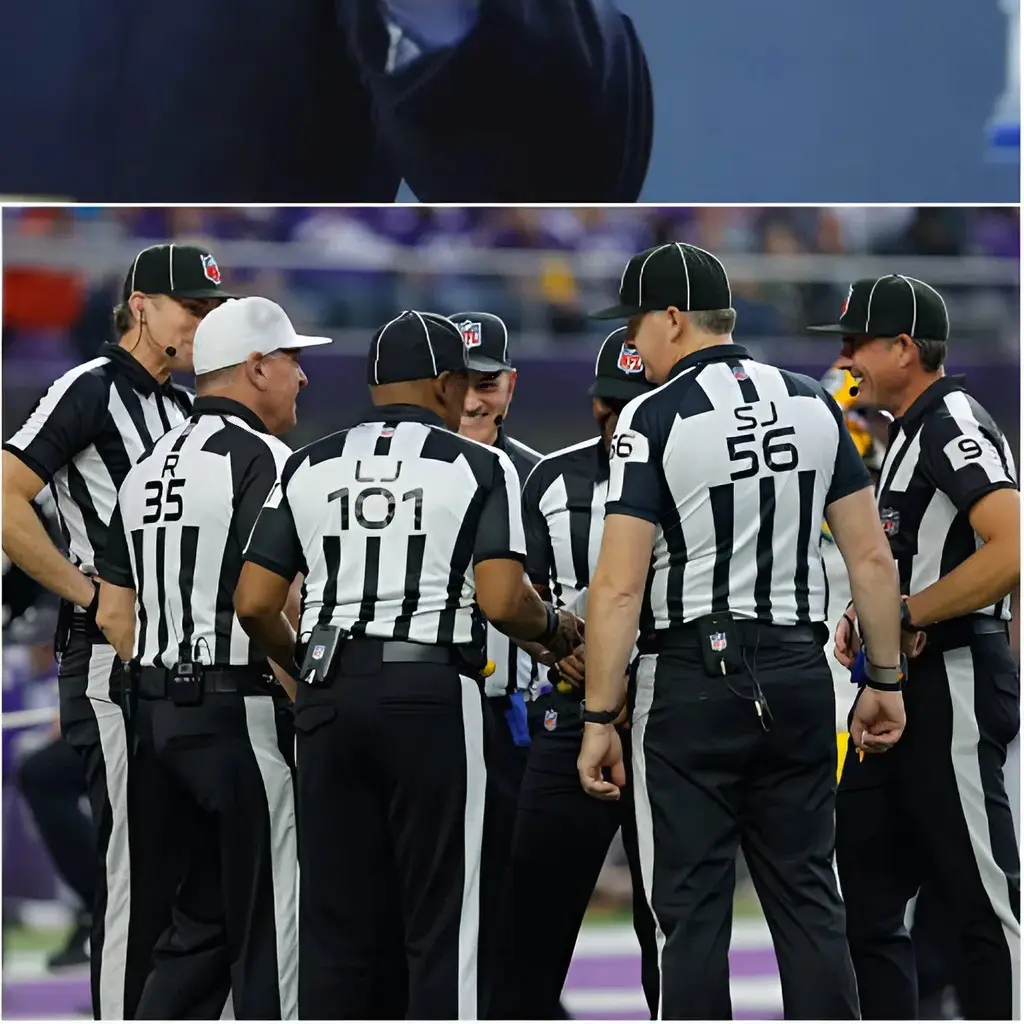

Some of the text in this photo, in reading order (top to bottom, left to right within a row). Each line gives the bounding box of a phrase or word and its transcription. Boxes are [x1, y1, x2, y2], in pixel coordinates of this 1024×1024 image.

[734, 401, 778, 431] SJ
[161, 454, 180, 478] R
[355, 460, 403, 483] LJ
[726, 426, 799, 482] 56
[143, 478, 186, 524] 35
[327, 487, 424, 531] 101
